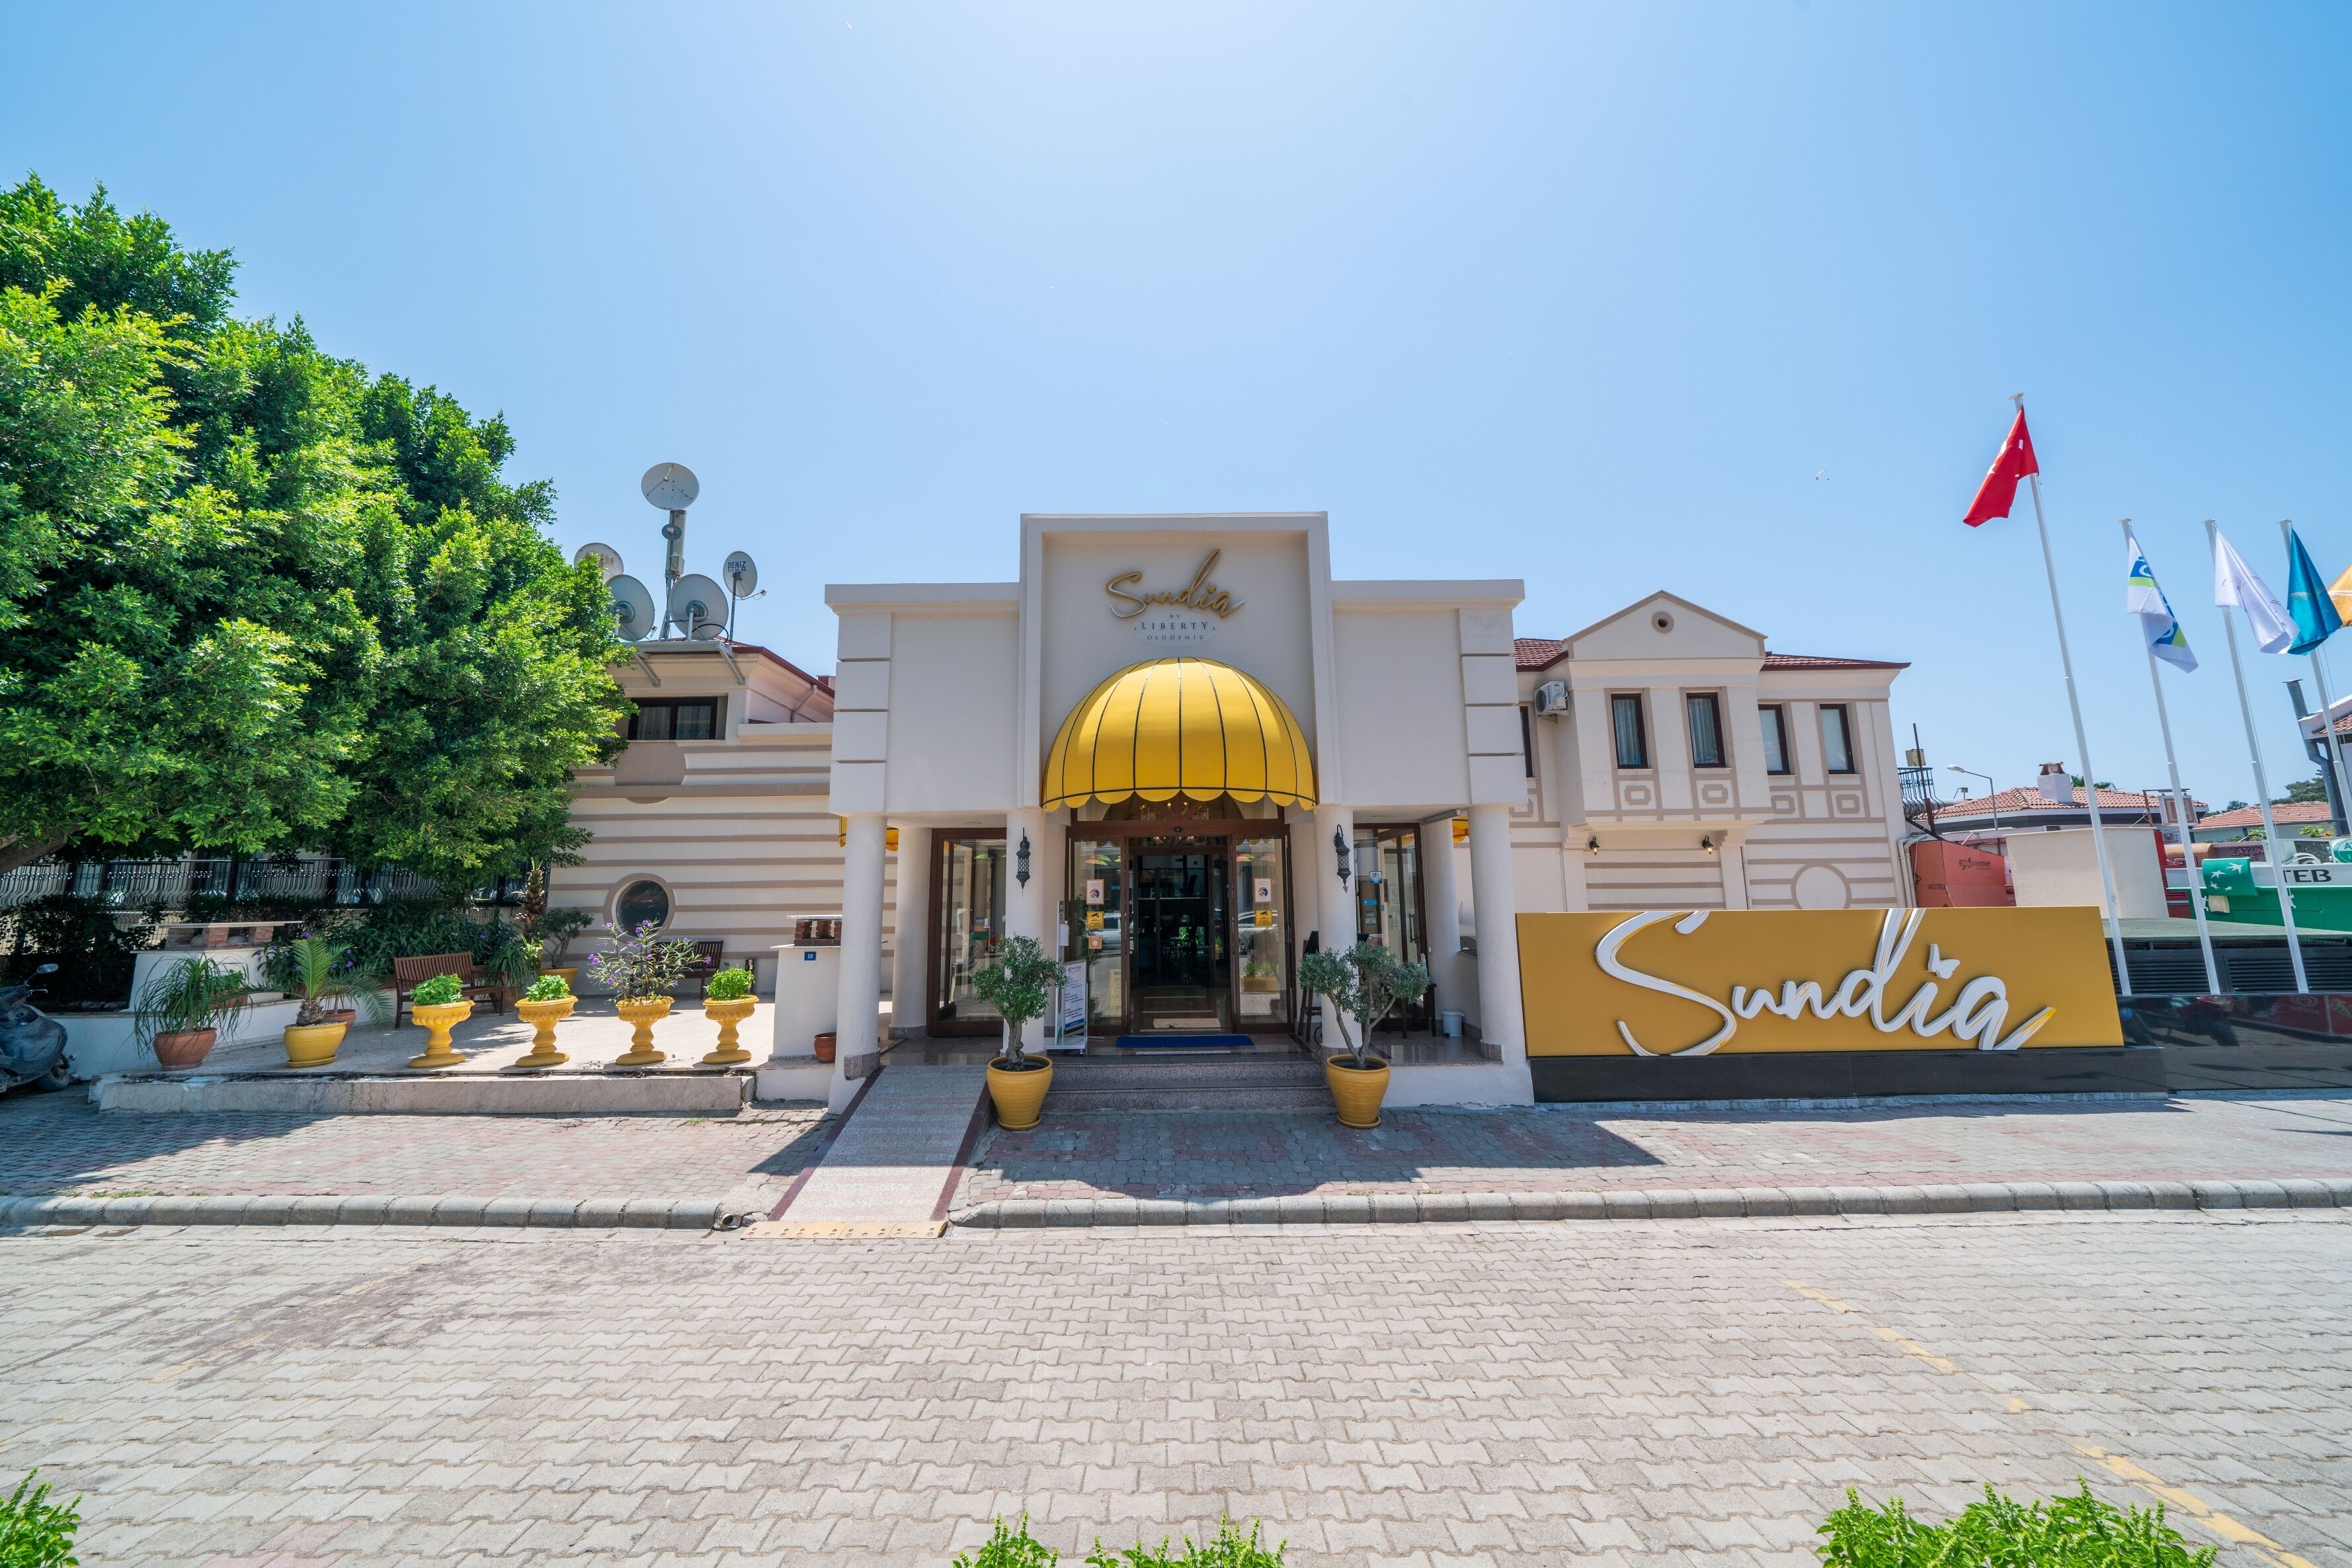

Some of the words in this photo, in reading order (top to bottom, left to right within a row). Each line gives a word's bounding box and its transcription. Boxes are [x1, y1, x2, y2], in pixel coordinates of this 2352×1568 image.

[1105, 548, 1245, 619] Sundia
[1142, 621, 1208, 630] LIBERTY
[1959, 857, 1991, 870] Extreme
[1595, 908, 2056, 1056] Sundia
